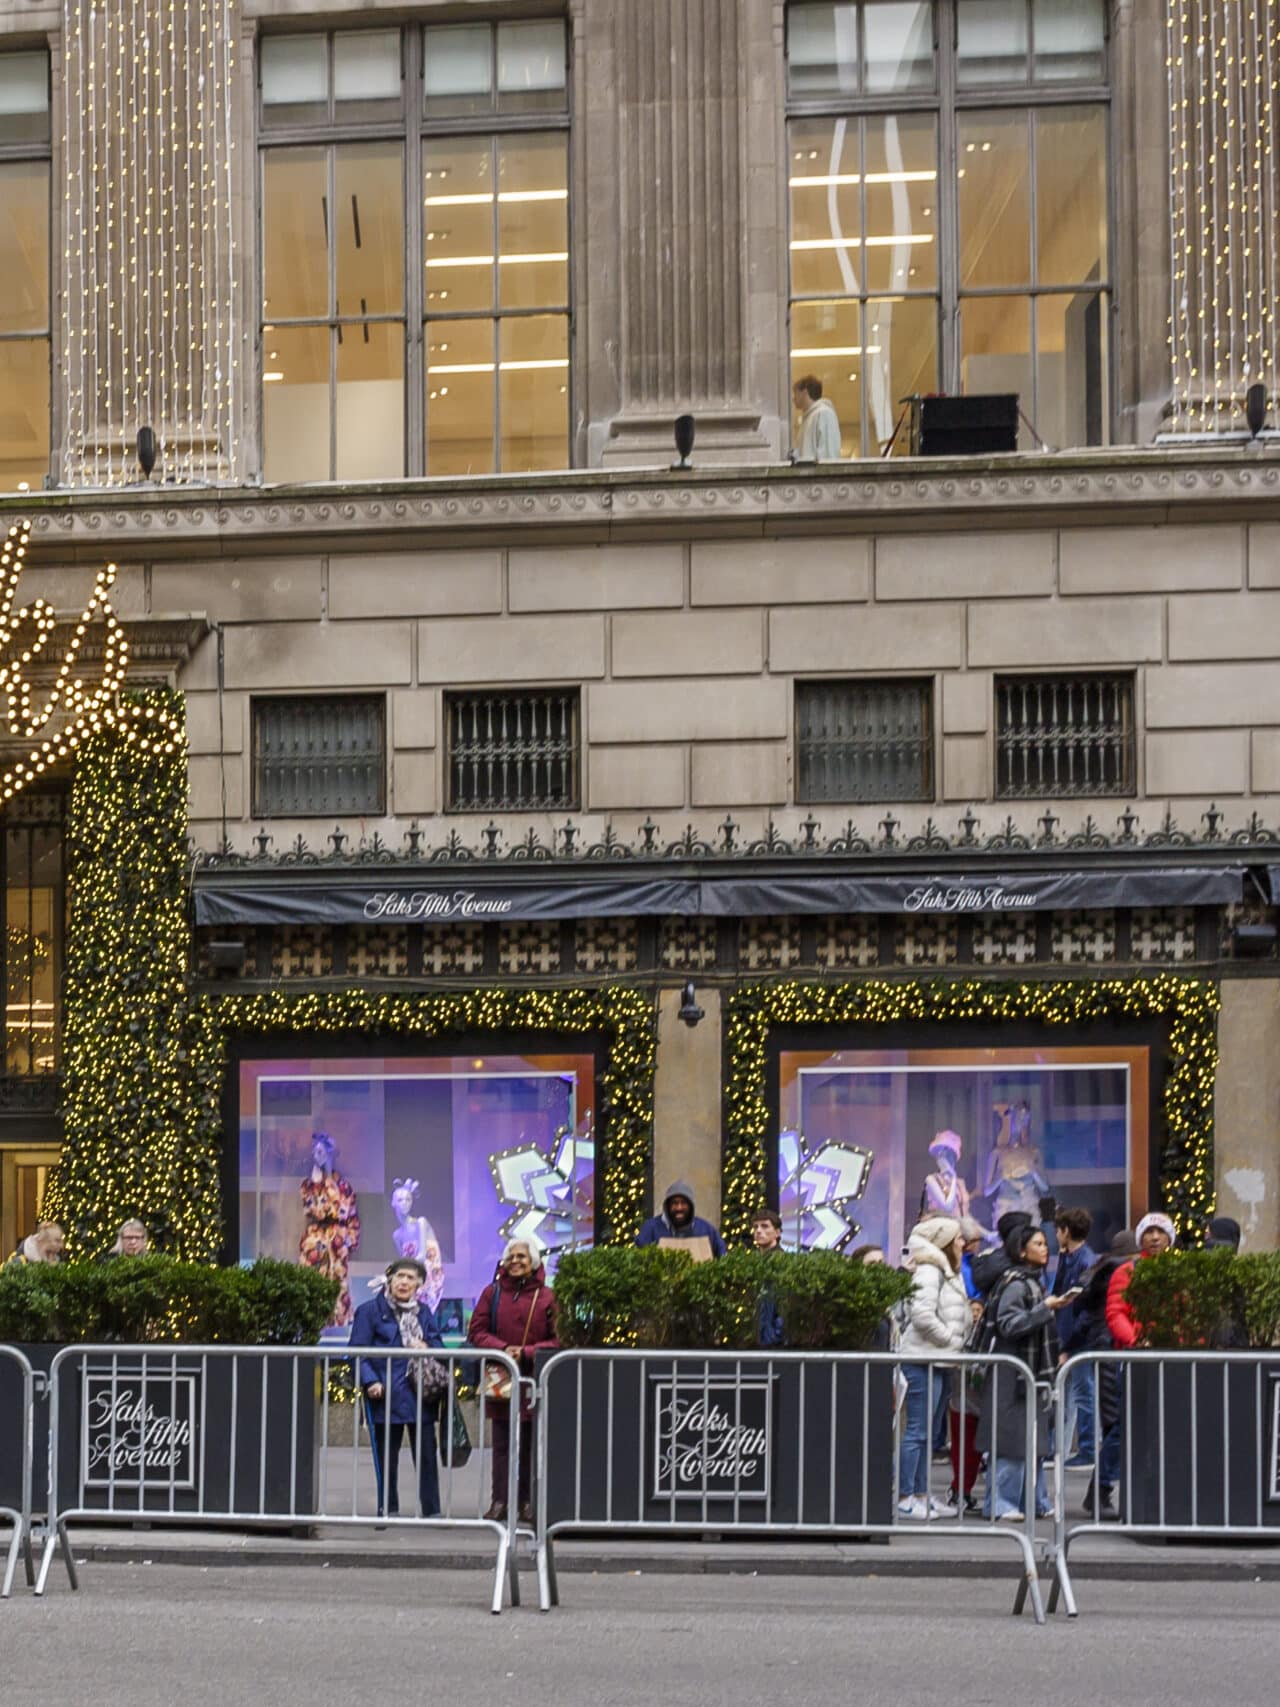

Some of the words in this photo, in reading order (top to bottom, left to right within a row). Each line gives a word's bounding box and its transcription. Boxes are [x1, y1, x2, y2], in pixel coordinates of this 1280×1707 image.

[363, 891, 411, 919] Saks
[406, 890, 451, 918] Fifth
[449, 890, 512, 917] Avenue
[904, 887, 947, 911] Saks
[942, 886, 983, 911] Fifth
[980, 886, 1037, 910] Avenue
[88, 1389, 154, 1429] Saks
[659, 1398, 729, 1439] Saks
[88, 1433, 182, 1471] Avenue
[122, 1416, 190, 1450] Fifth
[659, 1443, 757, 1482] Avenue
